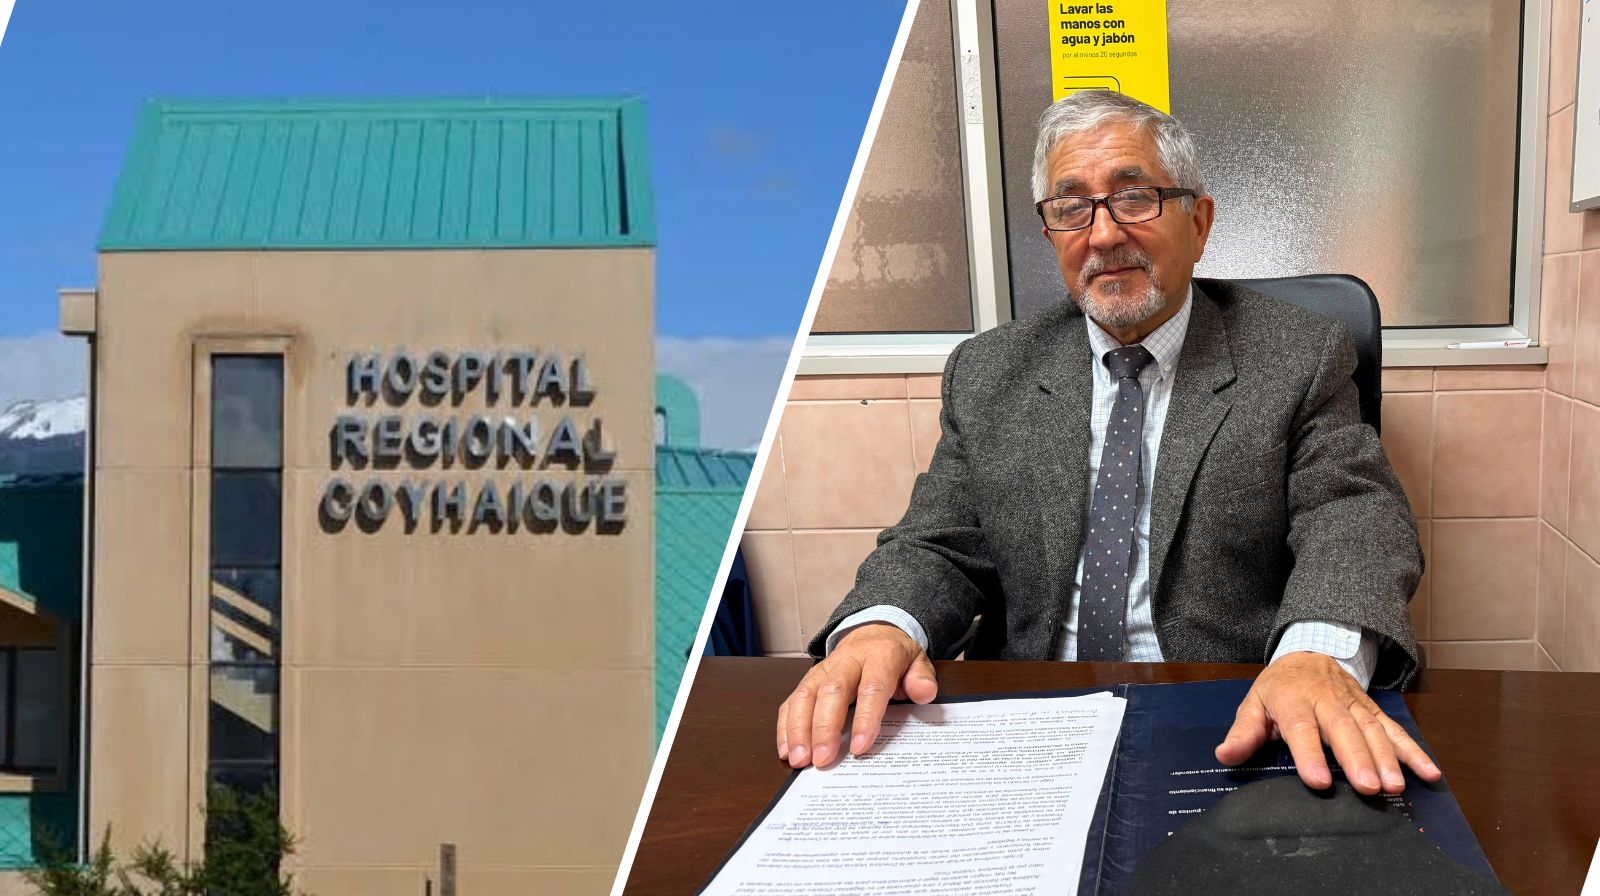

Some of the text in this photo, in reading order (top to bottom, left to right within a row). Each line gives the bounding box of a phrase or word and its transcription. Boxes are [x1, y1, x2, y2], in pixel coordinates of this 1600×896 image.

[1060, 2, 1113, 15] Lavar las
[1061, 19, 1125, 29] manos con
[1061, 32, 1135, 47] agua y jabón
[1109, 51, 1137, 59] segundos
[347, 350, 597, 406] HOSPITAL
[330, 414, 617, 473] REGIONAL
[318, 478, 629, 534] COYHAIQUE
